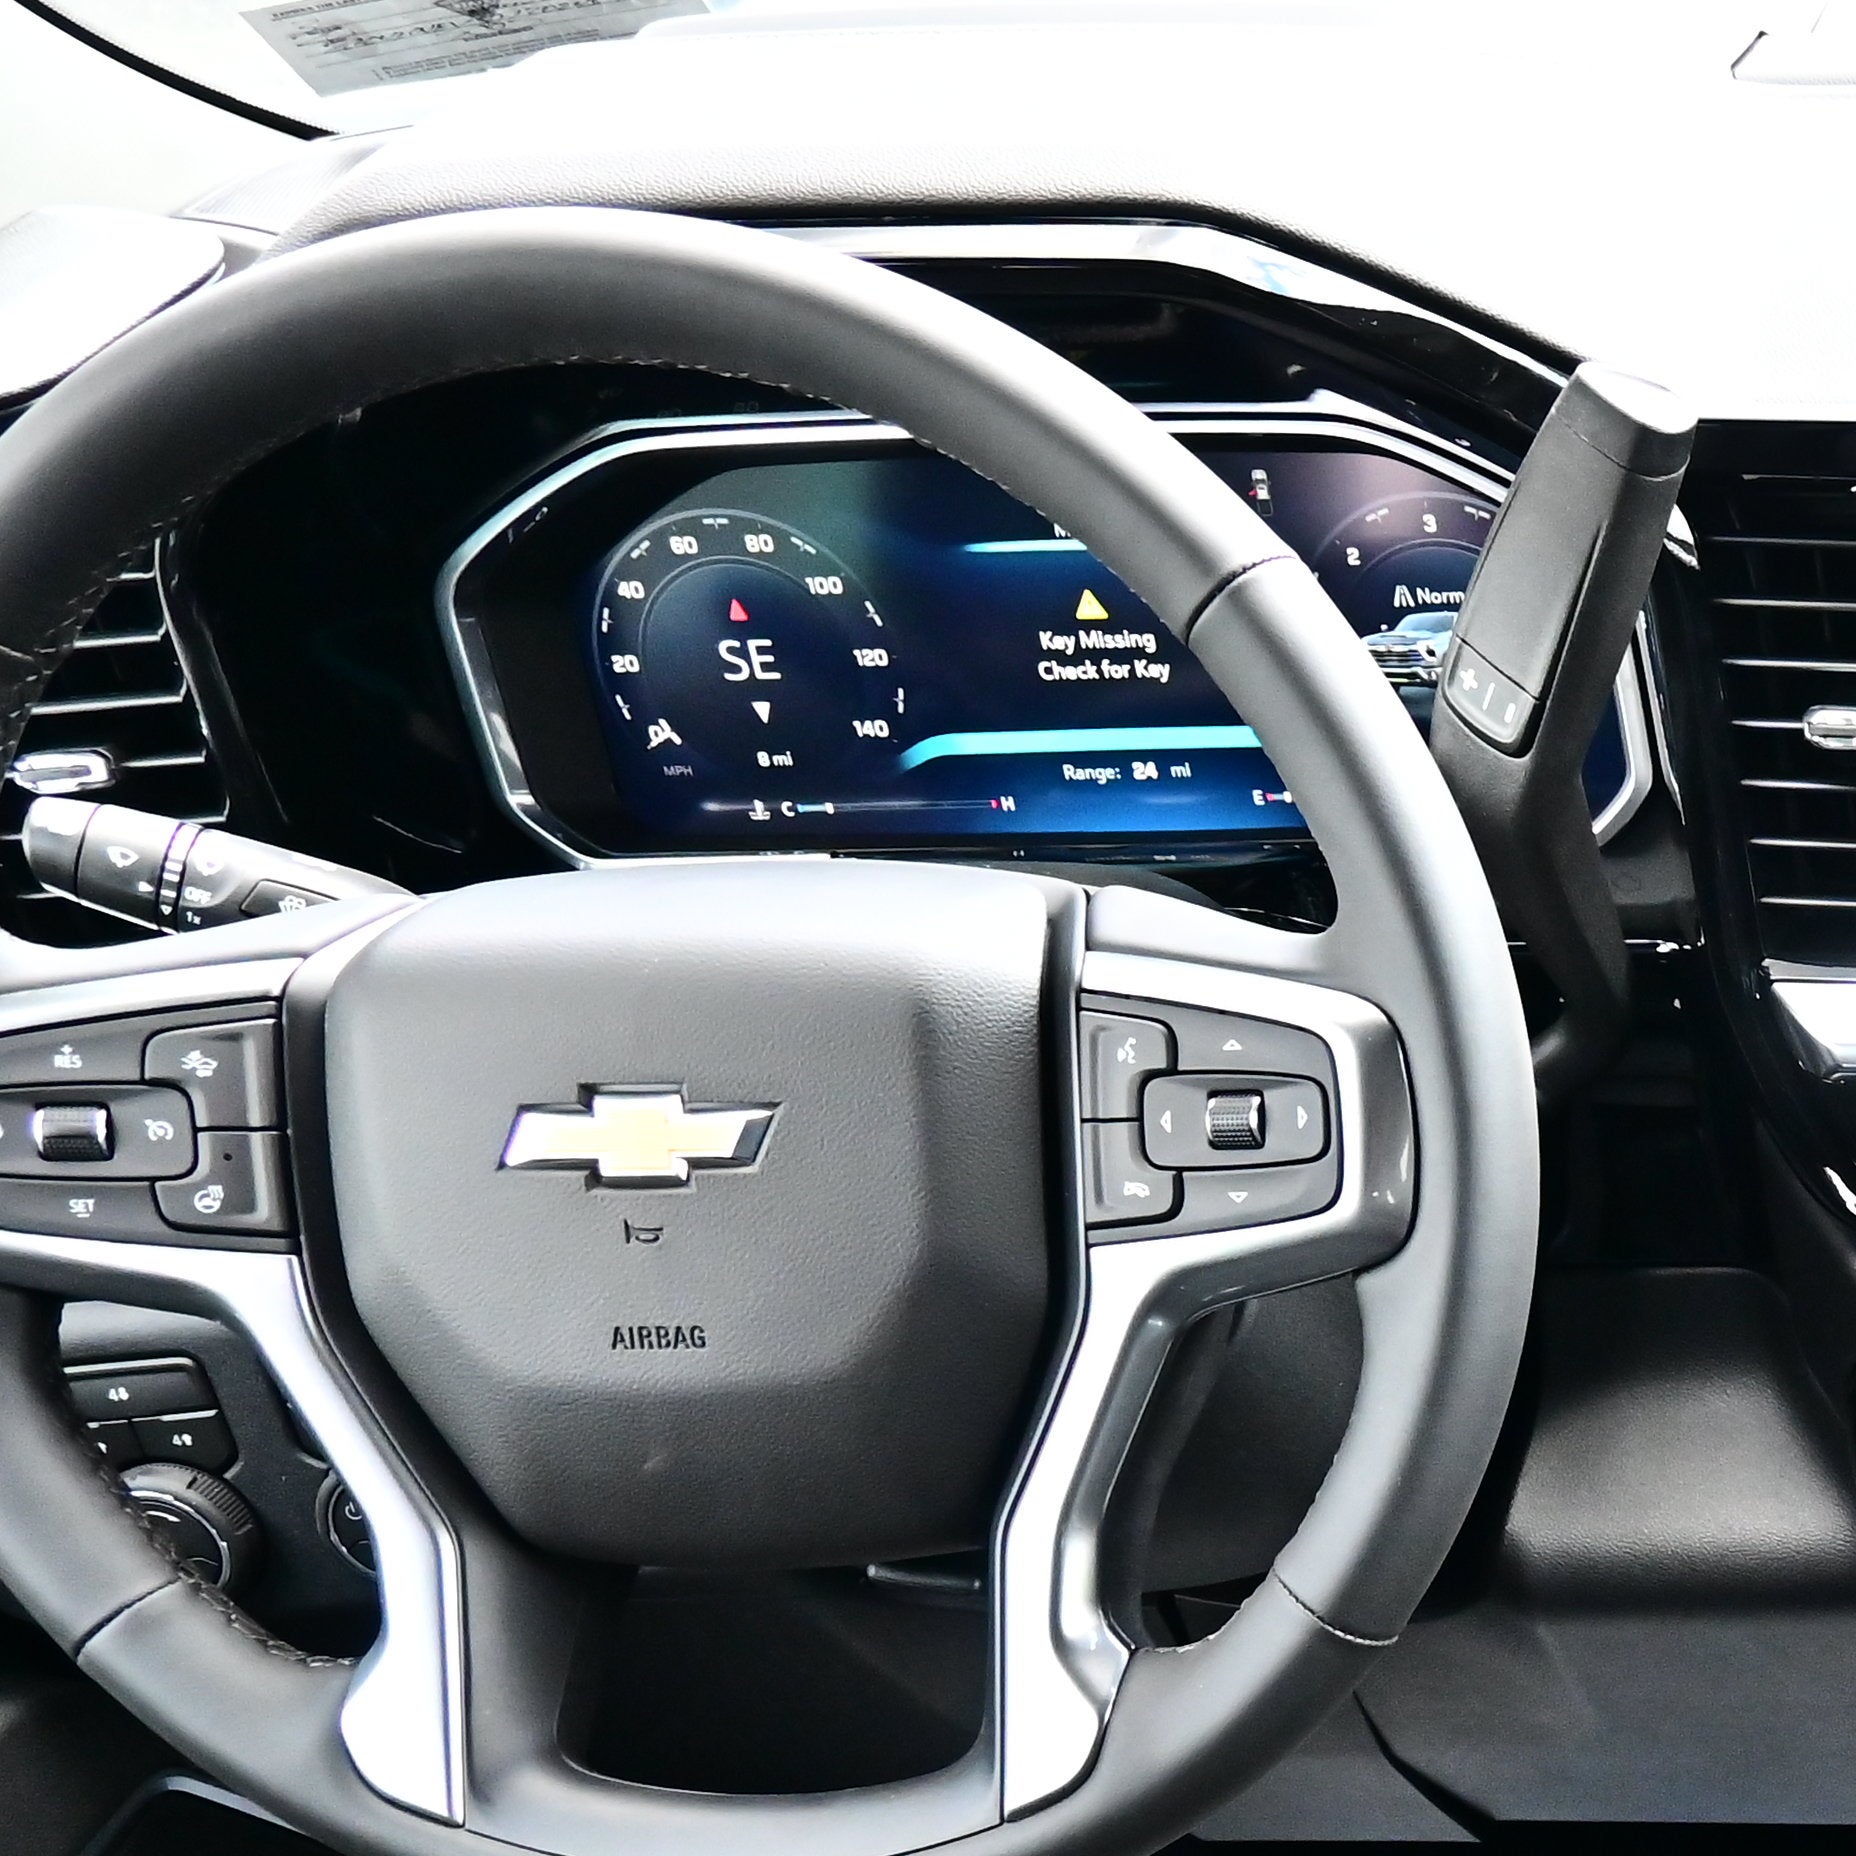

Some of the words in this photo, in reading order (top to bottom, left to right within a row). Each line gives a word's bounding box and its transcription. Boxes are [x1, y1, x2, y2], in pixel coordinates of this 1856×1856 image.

[1421, 513, 1438, 534] 3
[669, 535, 699, 555] 60
[744, 534, 775, 553] 80
[1346, 546, 1361, 567] 2
[617, 580, 646, 600] 40
[805, 575, 844, 596] 100
[1416, 586, 1466, 606] Norm
[1039, 630, 1076, 656] Key
[1079, 629, 1158, 655] Missing
[611, 654, 641, 674] 20
[717, 638, 782, 682] SE
[853, 648, 890, 668] 120
[1037, 659, 1100, 681] Check
[1101, 658, 1132, 680] for
[1134, 660, 1171, 684] Key
[853, 719, 890, 739] 140
[773, 750, 794, 768] mi
[663, 765, 694, 778] MPH
[1062, 762, 1122, 785] Range:
[1170, 761, 1192, 779] mi
[1000, 796, 1016, 812] H
[1252, 789, 1266, 806] E
[781, 801, 796, 818] C
[610, 1325, 707, 1351] AIRBAG
